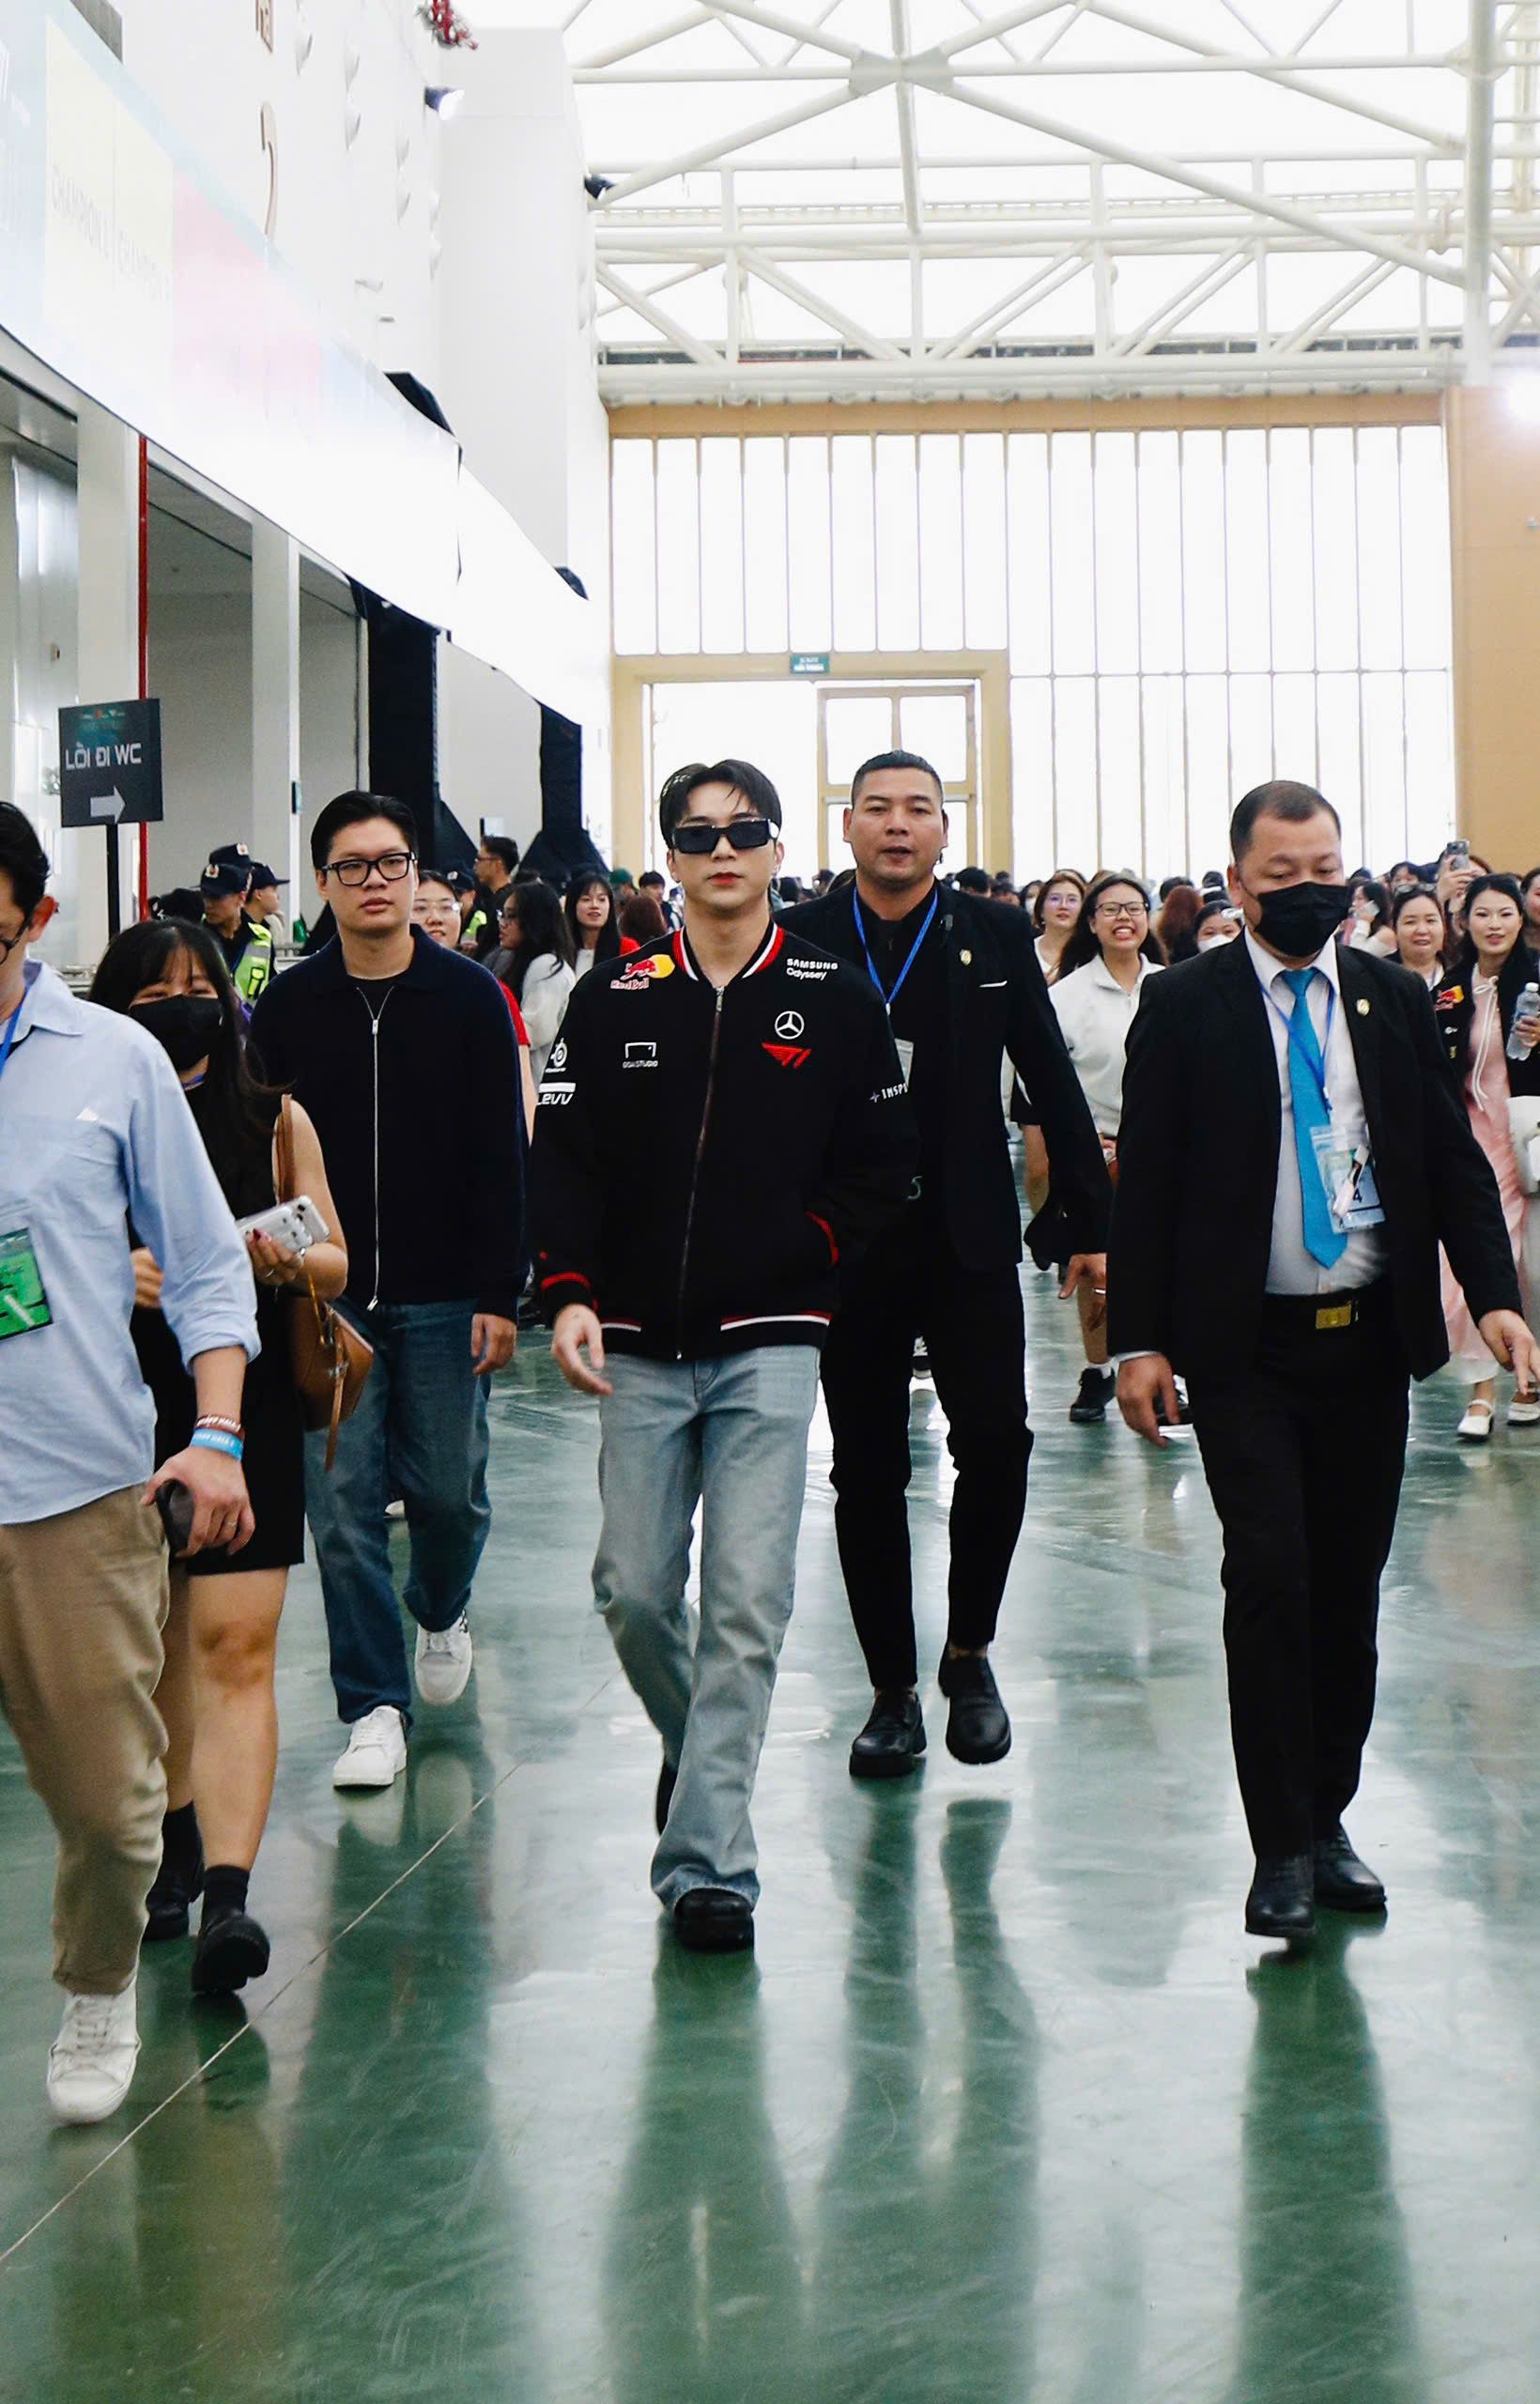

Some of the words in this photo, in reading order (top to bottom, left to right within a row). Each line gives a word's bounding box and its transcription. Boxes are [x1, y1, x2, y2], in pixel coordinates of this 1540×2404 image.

[96, 747, 110, 766] ĐI
[115, 743, 142, 765] WC
[787, 958, 839, 970] SAMSUNG
[786, 967, 827, 981] Odyssey
